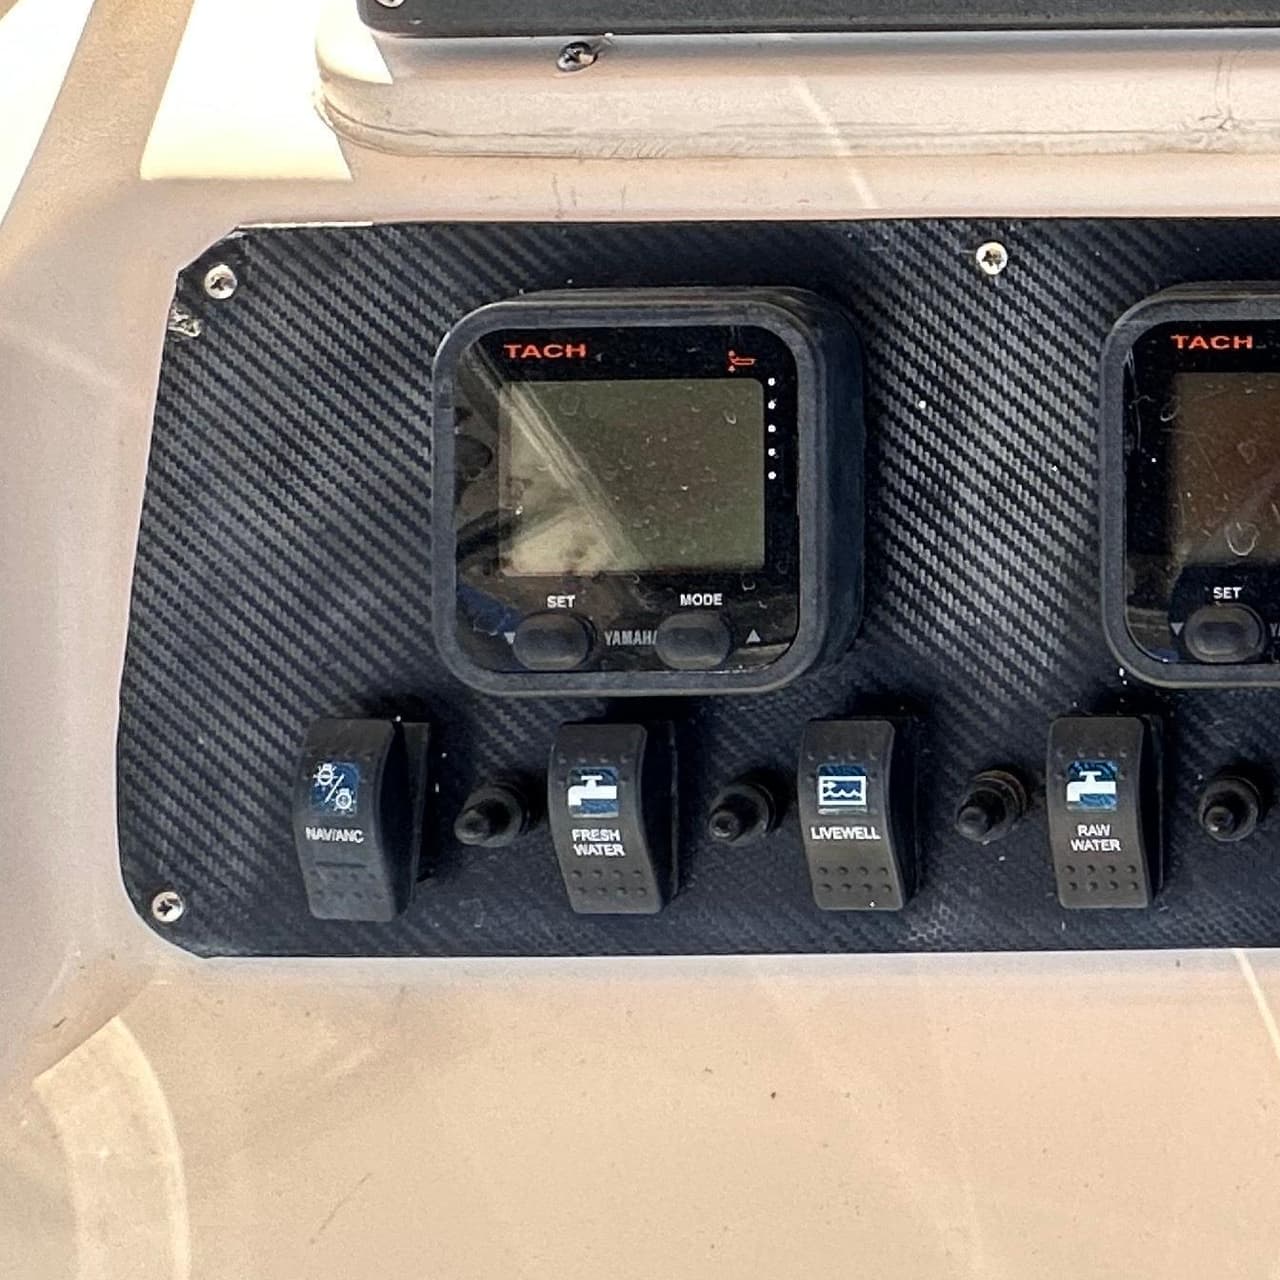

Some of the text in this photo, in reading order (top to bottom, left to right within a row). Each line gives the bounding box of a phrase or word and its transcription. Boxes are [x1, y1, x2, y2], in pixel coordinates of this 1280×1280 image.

[1170, 334, 1253, 350] TACH
[503, 343, 587, 359] TACH
[679, 592, 723, 606] MODE
[1213, 586, 1243, 600] SET
[546, 594, 576, 609] SET
[571, 828, 621, 842] FRESH
[810, 826, 882, 840] LIVEWELL
[1077, 823, 1111, 837] RAW
[572, 843, 626, 857] WATER
[1070, 838, 1122, 852] WATER
